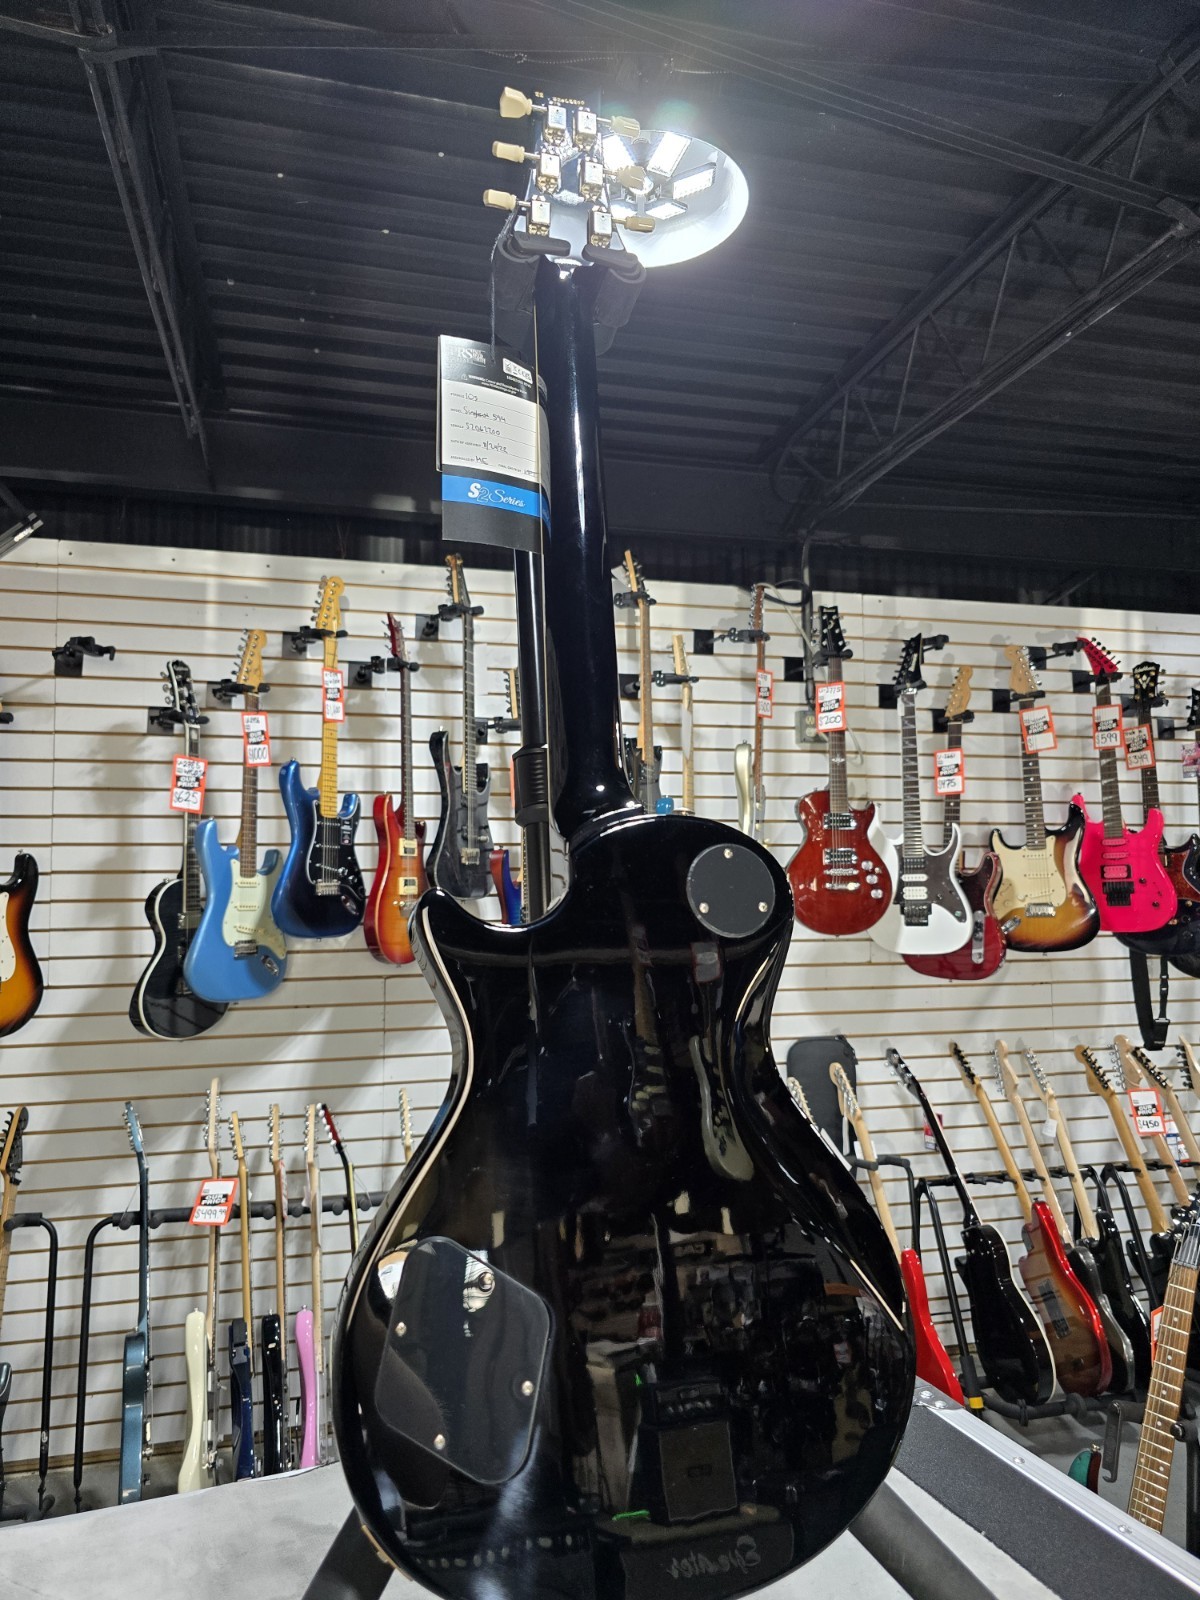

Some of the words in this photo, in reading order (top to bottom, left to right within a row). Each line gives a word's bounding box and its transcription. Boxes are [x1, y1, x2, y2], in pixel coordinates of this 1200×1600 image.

[489, 489, 526, 507] Series
[819, 714, 842, 726] $200
[1096, 732, 1118, 745] $599
[174, 791, 199, 804] $625
[1138, 1119, 1160, 1130] $450
